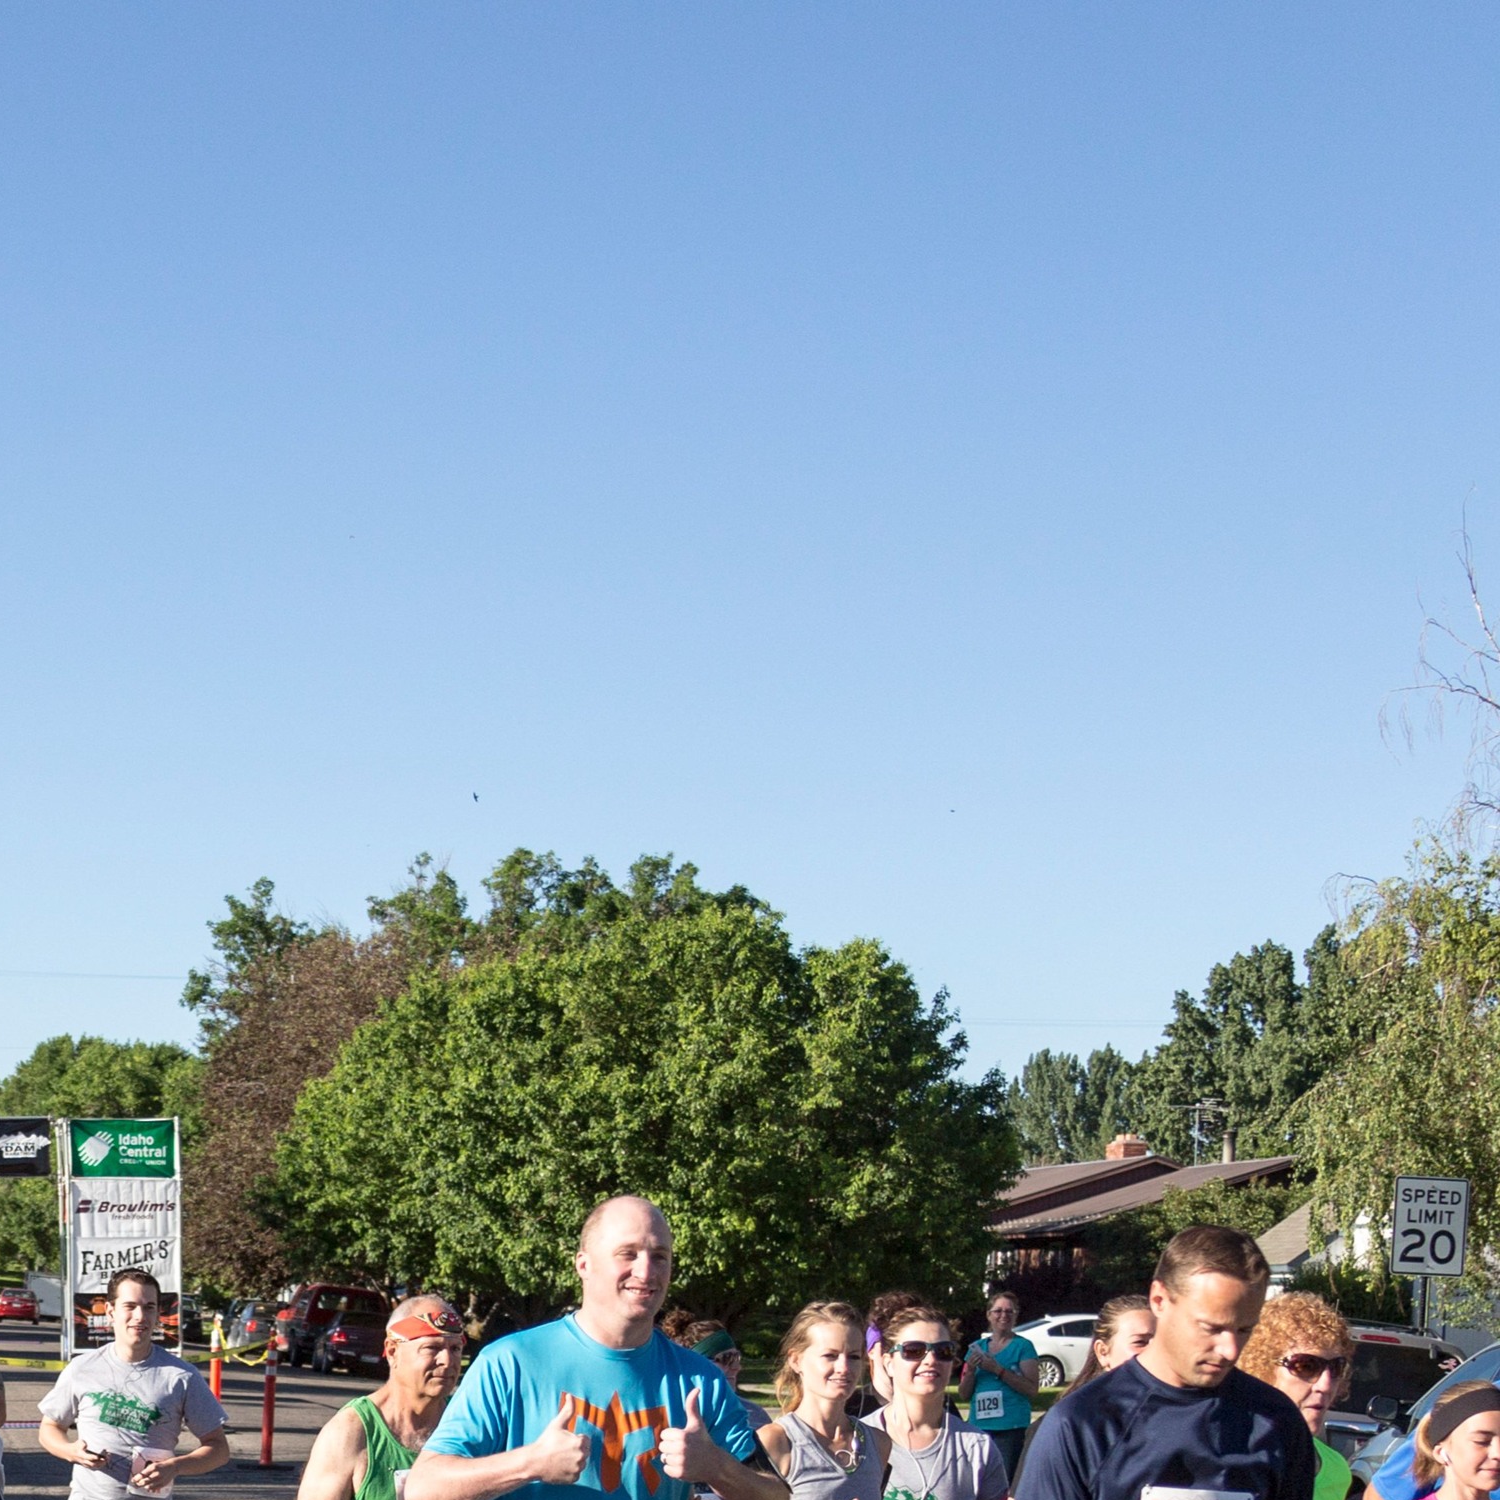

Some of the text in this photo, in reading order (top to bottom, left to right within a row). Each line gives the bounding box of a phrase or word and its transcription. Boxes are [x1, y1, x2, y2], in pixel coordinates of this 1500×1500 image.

[118, 1134, 154, 1145] Idaho
[118, 1146, 167, 1158] Central
[1401, 1188, 1462, 1206] SPEED
[97, 1200, 176, 1213] Broulim's
[1406, 1208, 1455, 1225] LIMIT
[1398, 1228, 1456, 1265] 20
[81, 1239, 169, 1276] FARMER'S
[977, 1397, 999, 1412] 1129
